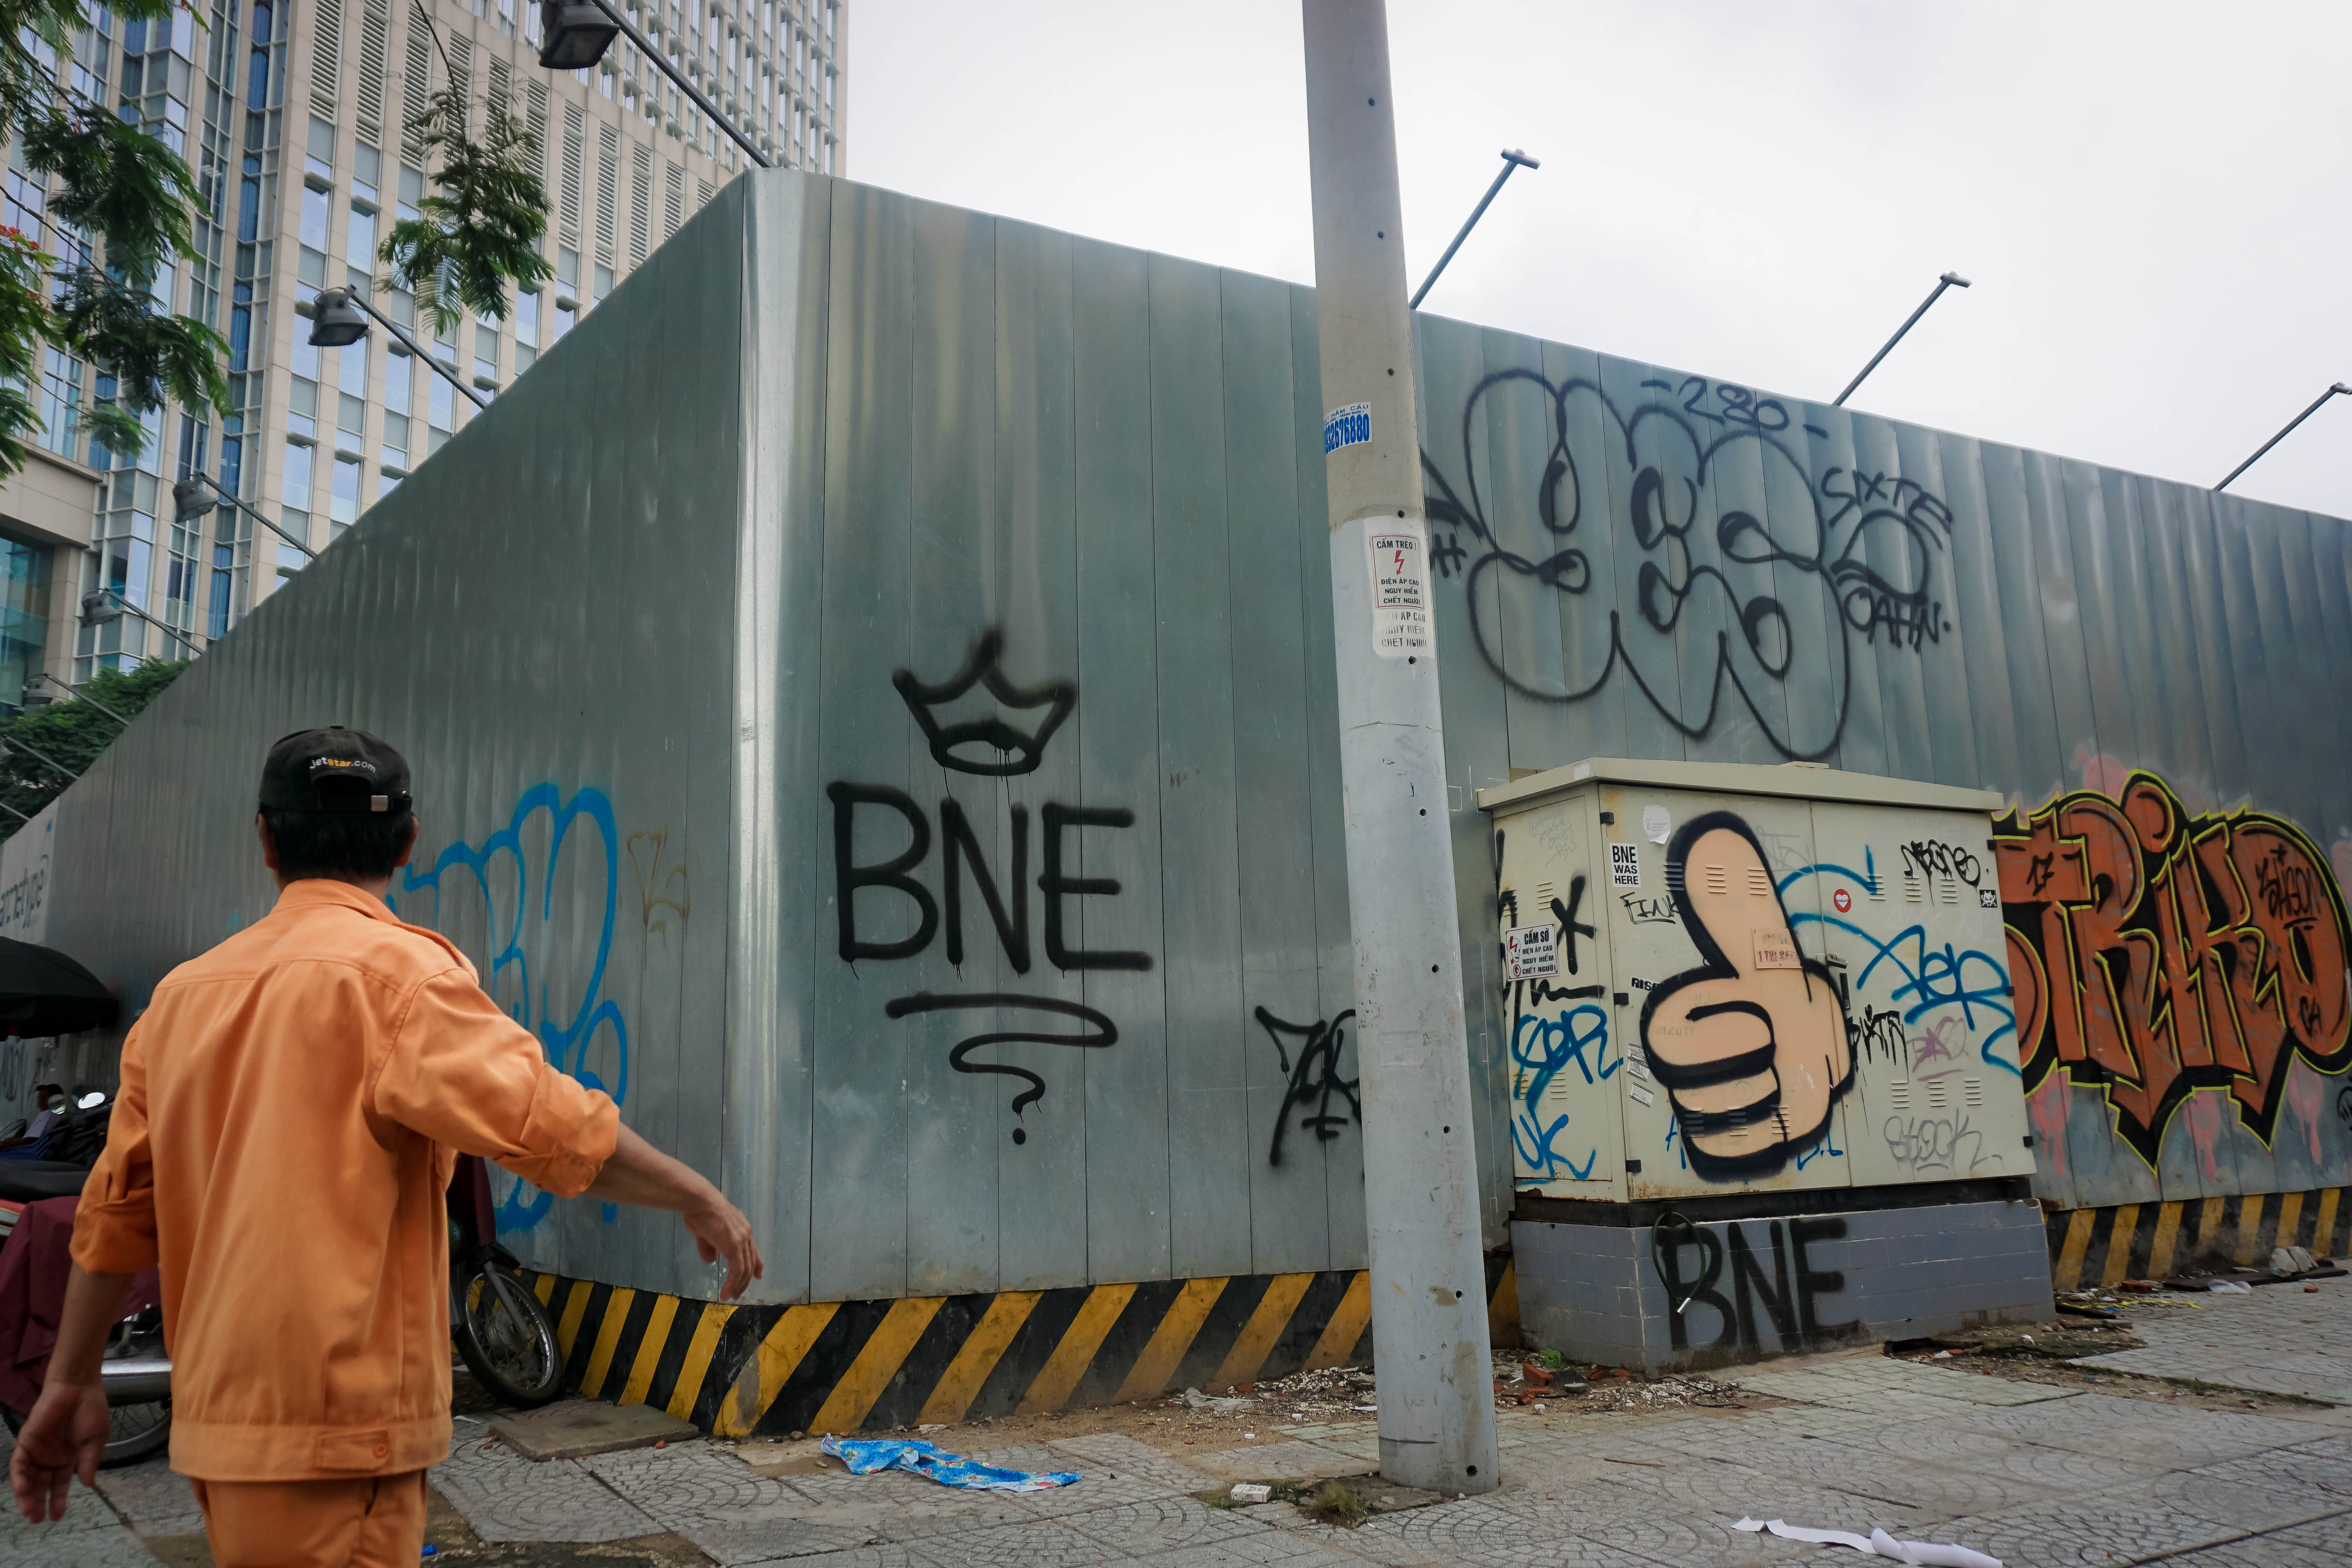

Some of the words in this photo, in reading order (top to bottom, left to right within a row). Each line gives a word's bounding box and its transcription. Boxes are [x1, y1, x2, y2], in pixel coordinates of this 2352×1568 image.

[1377, 538, 1393, 549] CẤM
[1395, 539, 1413, 549] TRÈO
[1381, 577, 1397, 585] ĐIỆN
[1404, 586, 1418, 595] HIỂM
[1384, 595, 1401, 604] CHẾT
[1612, 845, 1637, 864] BNE
[1614, 864, 1638, 874] WAS
[827, 780, 1154, 975] BNE
[1615, 875, 1639, 885] HERE
[1525, 929, 1538, 945] CẤM
[1539, 953, 1554, 962] HIỂM
[1523, 966, 1536, 974] CHẾT
[1538, 964, 1556, 972] NGƯỜI
[1656, 1218, 1865, 1352] BNE
